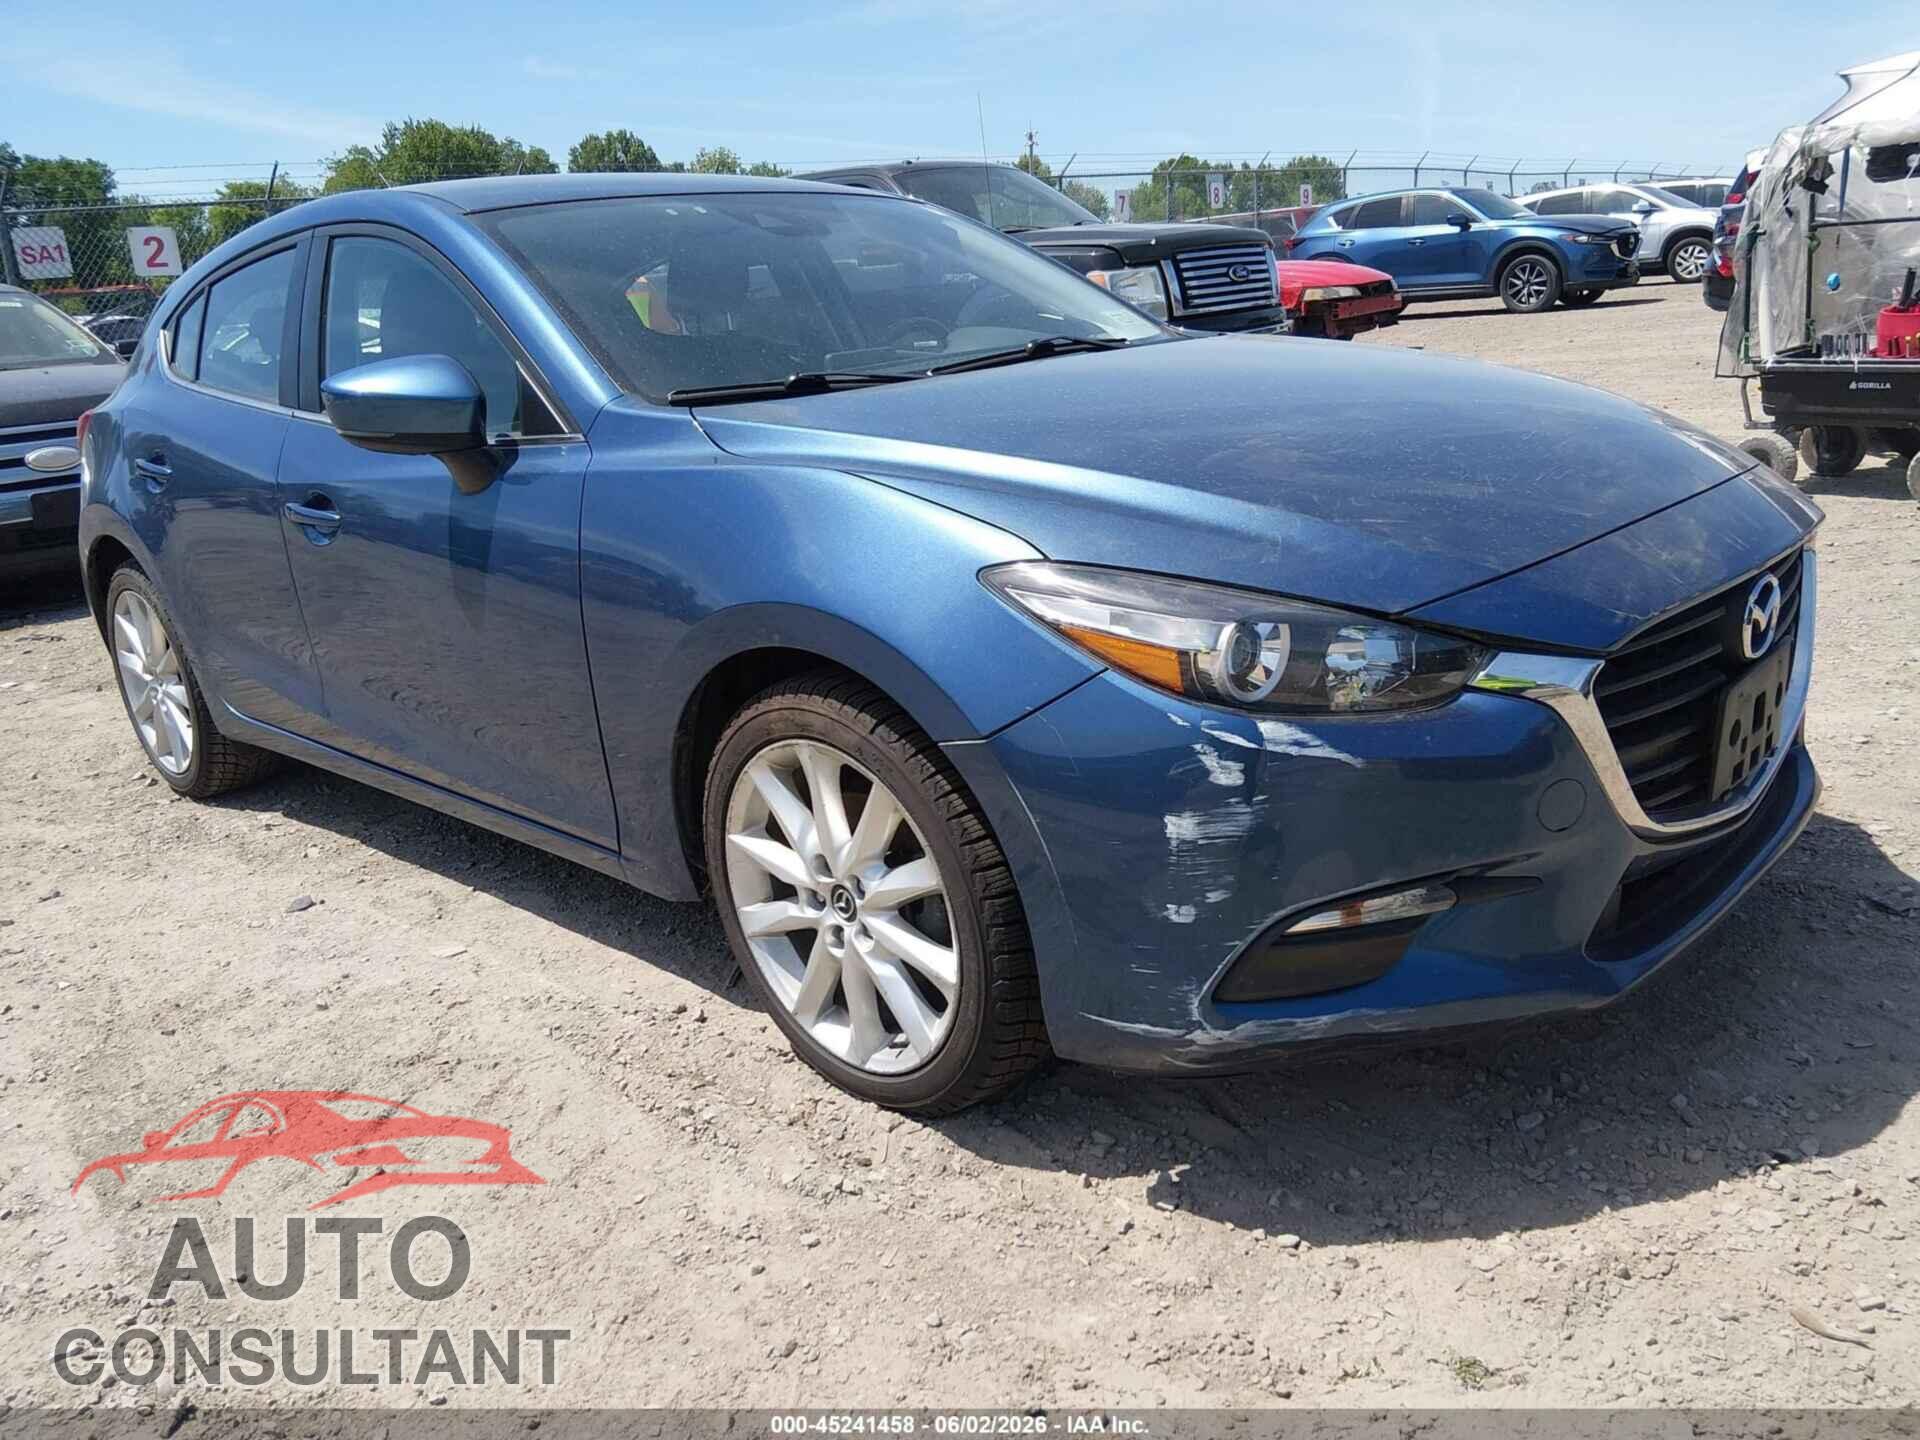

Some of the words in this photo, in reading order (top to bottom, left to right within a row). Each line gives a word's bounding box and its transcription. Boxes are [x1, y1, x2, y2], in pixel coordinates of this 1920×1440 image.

[1118, 195, 1126, 213] 7
[1213, 186, 1220, 205] 8
[1303, 188, 1310, 205] 9
[20, 244, 65, 265] SA1
[143, 236, 169, 268] 2
[1857, 381, 1891, 389] GORILLA
